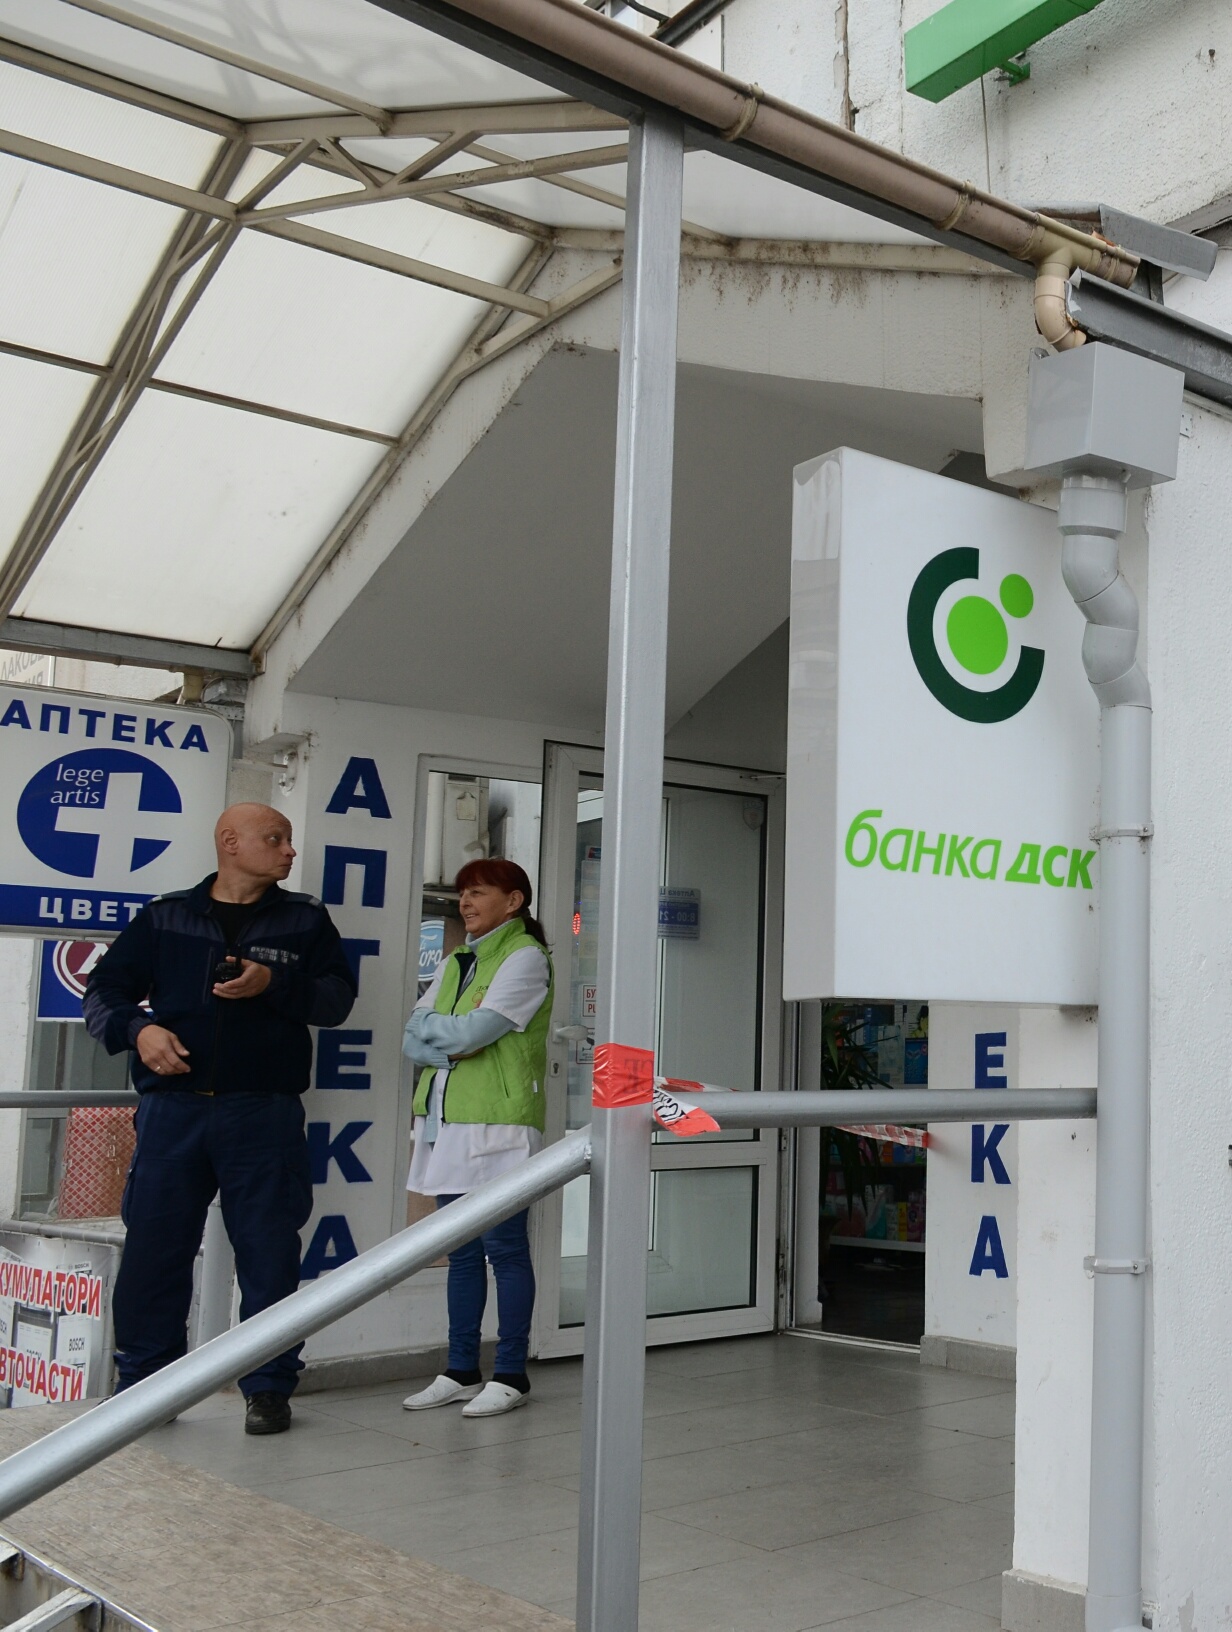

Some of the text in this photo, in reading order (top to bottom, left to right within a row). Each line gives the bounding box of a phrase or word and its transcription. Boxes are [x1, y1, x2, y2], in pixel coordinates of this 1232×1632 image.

[0, 699, 209, 752] АПТЕКА
[56, 763, 104, 787] lege
[50, 787, 100, 804] artis
[69, 1338, 85, 1351] BOSCH
